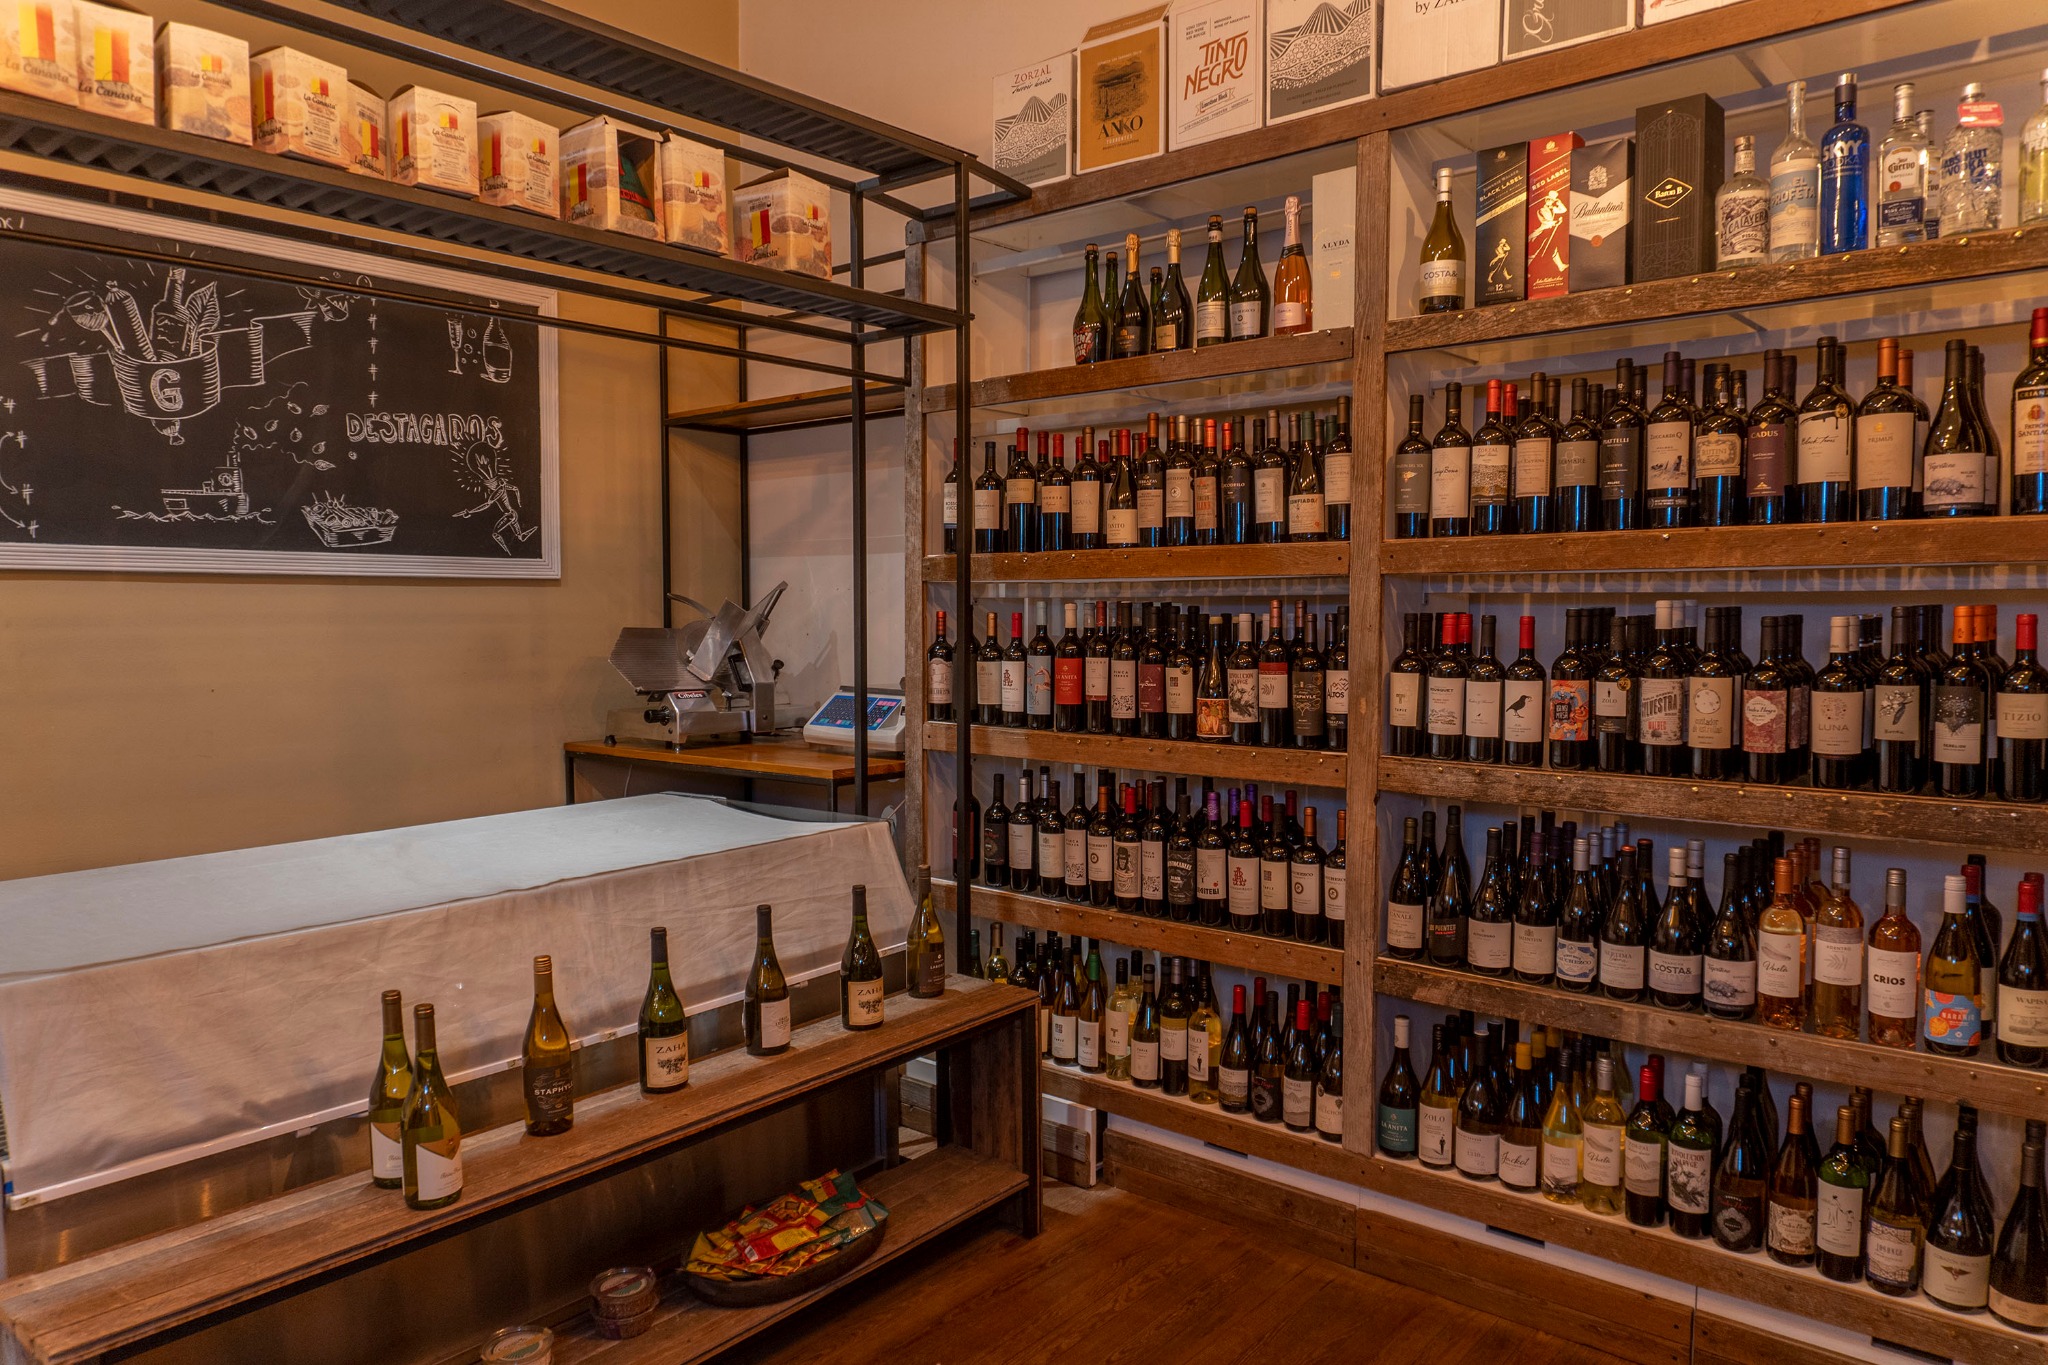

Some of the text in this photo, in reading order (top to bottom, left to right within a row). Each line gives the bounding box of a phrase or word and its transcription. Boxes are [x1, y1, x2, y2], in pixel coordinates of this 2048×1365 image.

[1415, 1, 1429, 14] by
[1199, 31, 1249, 71] TINTO
[1014, 65, 1052, 84] ZORZAL
[1184, 58, 1247, 100] NEGRO
[78, 79, 142, 104] La Canasta
[314, 96, 336, 110] Canasta
[1098, 115, 1143, 140] ANKO
[1822, 140, 1862, 162] SKYY
[362, 159, 384, 176] Canasta
[1888, 162, 1916, 174] Cuervo
[484, 180, 508, 192] Canasta
[1532, 168, 1570, 191] RED LABEL
[1792, 176, 1808, 188] EL
[1479, 175, 1524, 202] BLACK LABEL
[1654, 186, 1683, 199] Baron B
[1772, 186, 1817, 206] PROFETA
[572, 206, 594, 221] Canasta
[1573, 200, 1624, 220] Ballantine's
[1321, 238, 1350, 250] ALYDA
[753, 248, 778, 262] Canasta
[1495, 284, 1504, 292] 12
[2002, 712, 2042, 722] TIZIO
[1390, 912, 1413, 920] CANALE
[1873, 974, 1906, 986] CRIOS
[656, 1042, 686, 1054] ZAHA
[1424, 1112, 1446, 1123] ZOLO
[1388, 1122, 1408, 1132] ANITA
